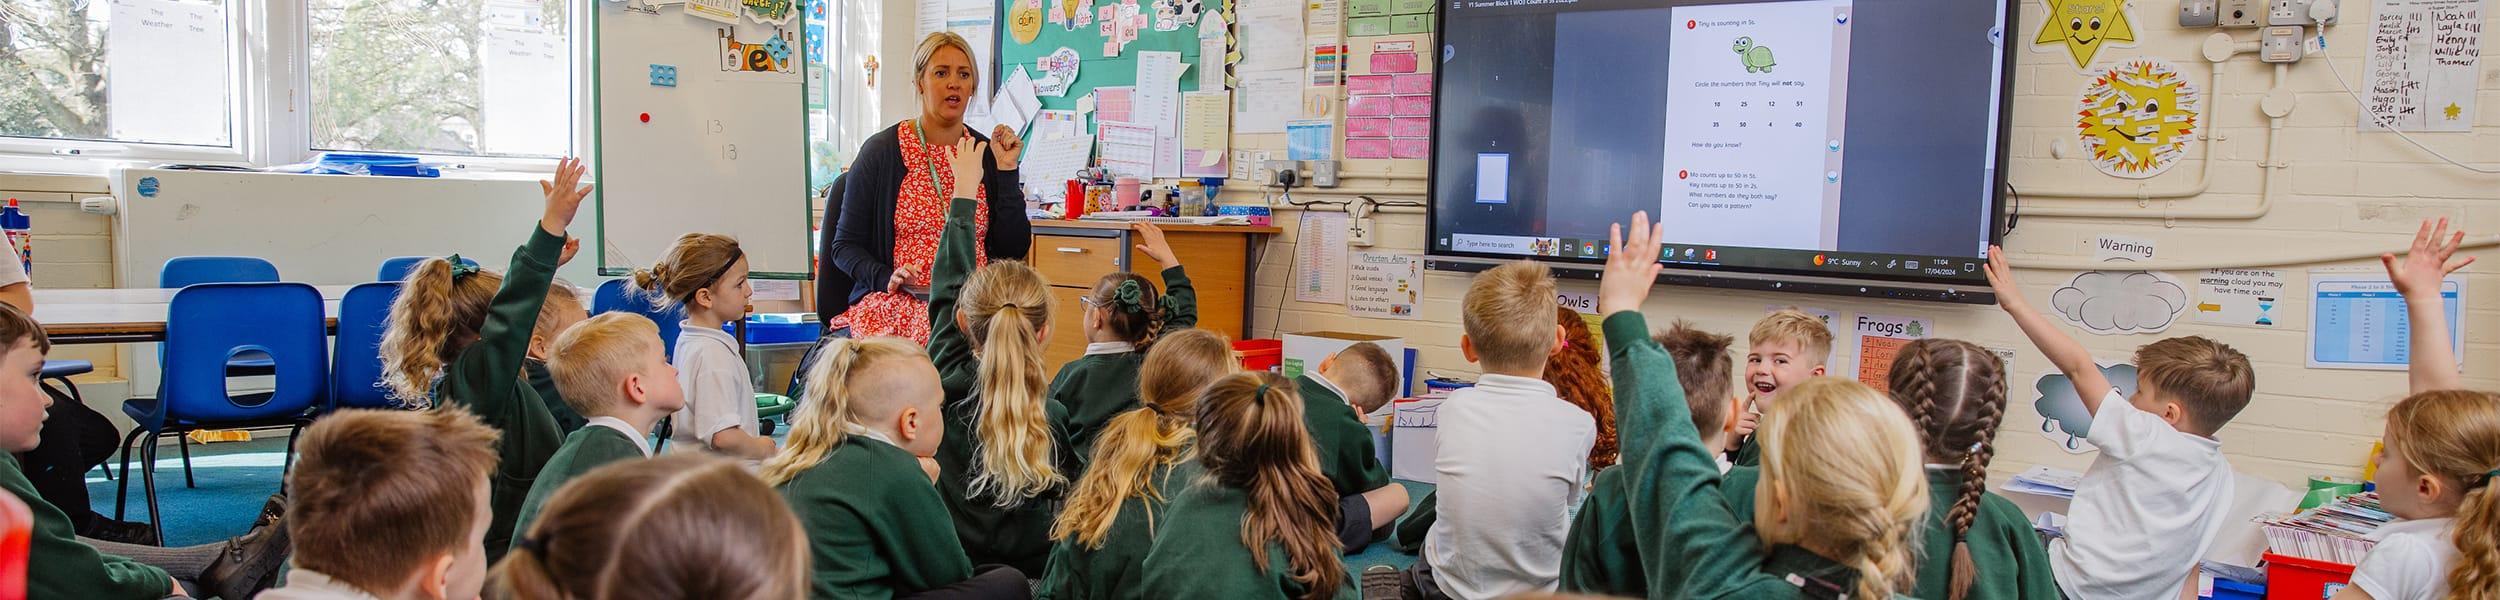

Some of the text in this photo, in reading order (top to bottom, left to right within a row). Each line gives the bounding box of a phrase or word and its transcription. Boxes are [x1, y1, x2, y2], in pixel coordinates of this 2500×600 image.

[151, 8, 163, 16] The
[2436, 10, 2465, 21] Noah
[141, 19, 173, 28] Weather
[1717, 20, 1740, 28] counting
[2437, 22, 2462, 36] Layla
[2437, 34, 2467, 51] Henry
[2372, 95, 2396, 107] Hugo
[706, 119, 724, 137] 13
[721, 143, 738, 161] 13
[1466, 240, 1478, 248] Type
[2099, 238, 2154, 257] Warning
[1828, 257, 1862, 268] 9°C Sunny
[1933, 258, 1949, 266] 11:04
[1924, 268, 1956, 276] 17/04/2024
[2200, 277, 2229, 286] warning
[2230, 278, 2251, 286] cloud
[1368, 287, 1388, 295] language
[2233, 287, 2250, 295] time
[1557, 295, 1590, 308] Owls
[1857, 317, 1903, 337] Frogs
